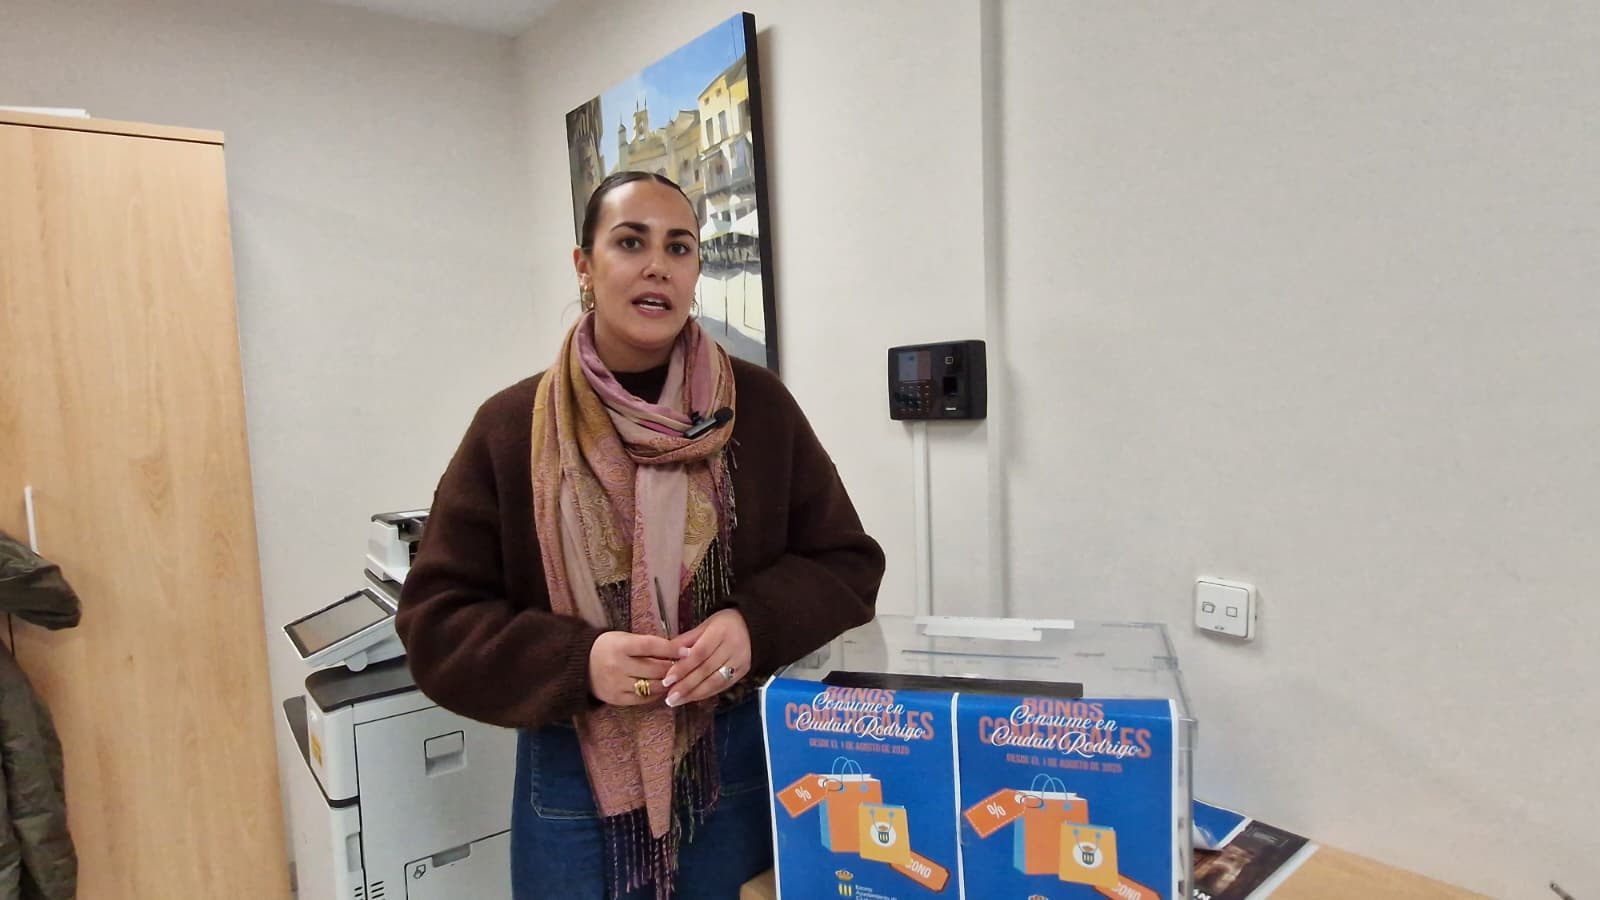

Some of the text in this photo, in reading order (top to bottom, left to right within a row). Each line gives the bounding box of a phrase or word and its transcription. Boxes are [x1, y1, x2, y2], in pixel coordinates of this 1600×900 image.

[812, 691, 906, 715] Consume en
[1022, 697, 1104, 721] BONOS
[795, 711, 927, 741] Ciudad Rodrigo
[1010, 705, 1118, 732] Consume en
[991, 726, 1142, 759] Ciudad Rodrigo
[986, 801, 1006, 820] %
